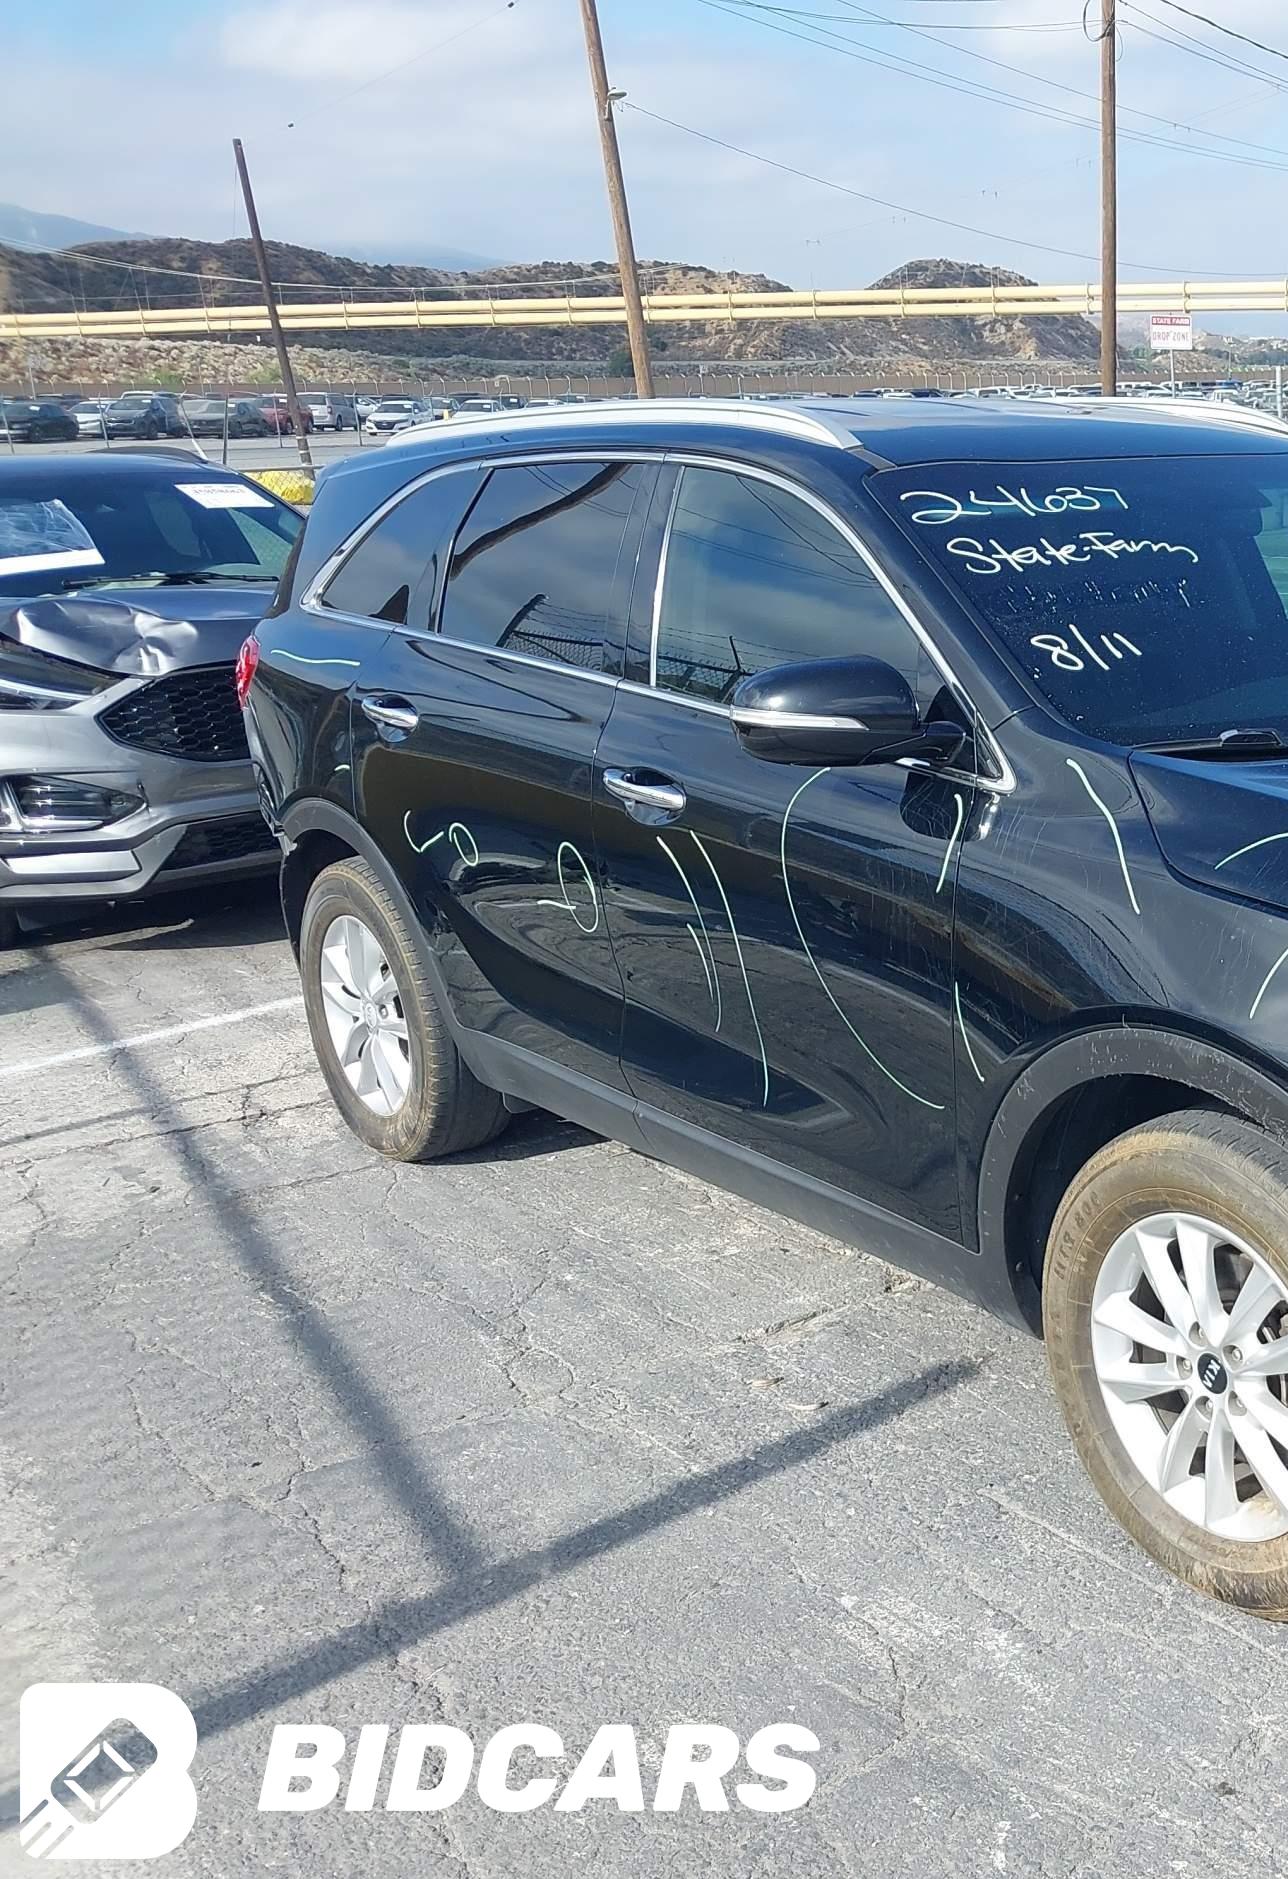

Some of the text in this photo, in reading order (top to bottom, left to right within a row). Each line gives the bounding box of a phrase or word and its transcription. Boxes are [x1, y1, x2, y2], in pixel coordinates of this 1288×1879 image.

[1152, 331, 1189, 341] DROP ZONE
[900, 485, 1129, 525] 24637
[1030, 623, 1143, 671] 8/11
[1203, 1359, 1221, 1388] KIA
